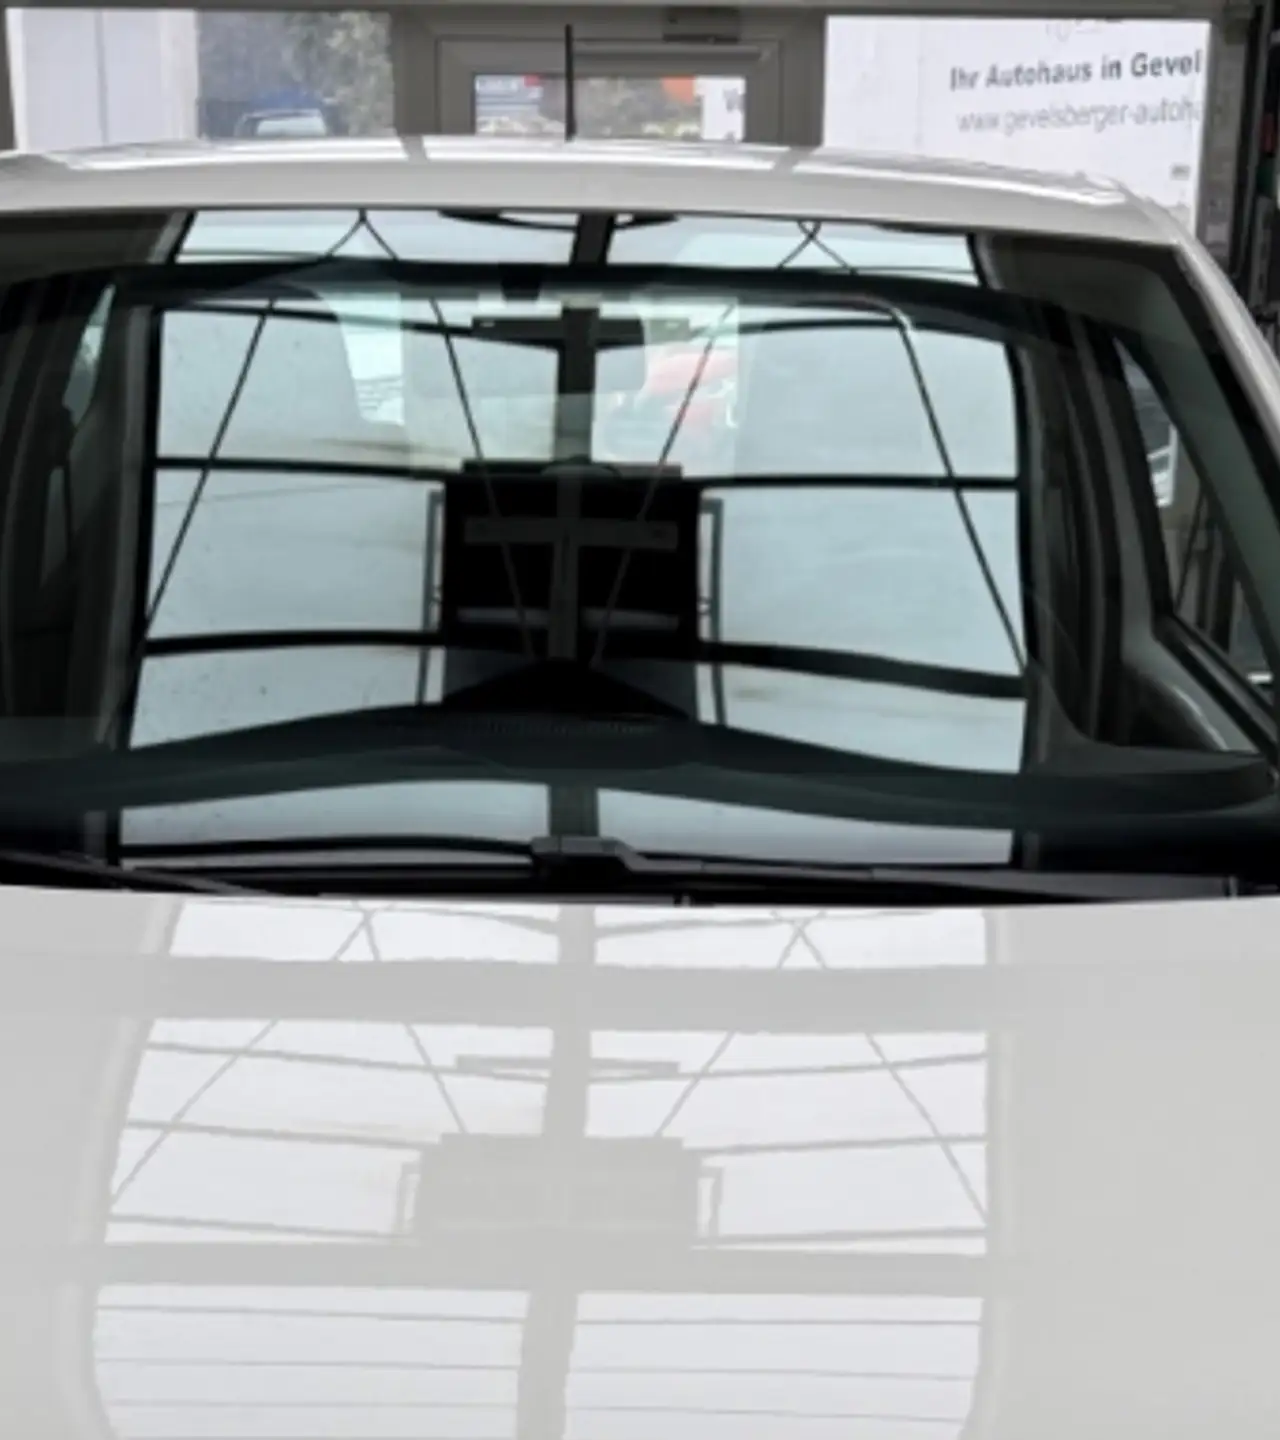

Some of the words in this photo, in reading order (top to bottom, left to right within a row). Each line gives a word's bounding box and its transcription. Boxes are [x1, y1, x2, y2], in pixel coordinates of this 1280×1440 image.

[950, 66, 978, 91] Ihr
[985, 58, 1092, 89] Autohaus
[1101, 52, 1122, 80] in
